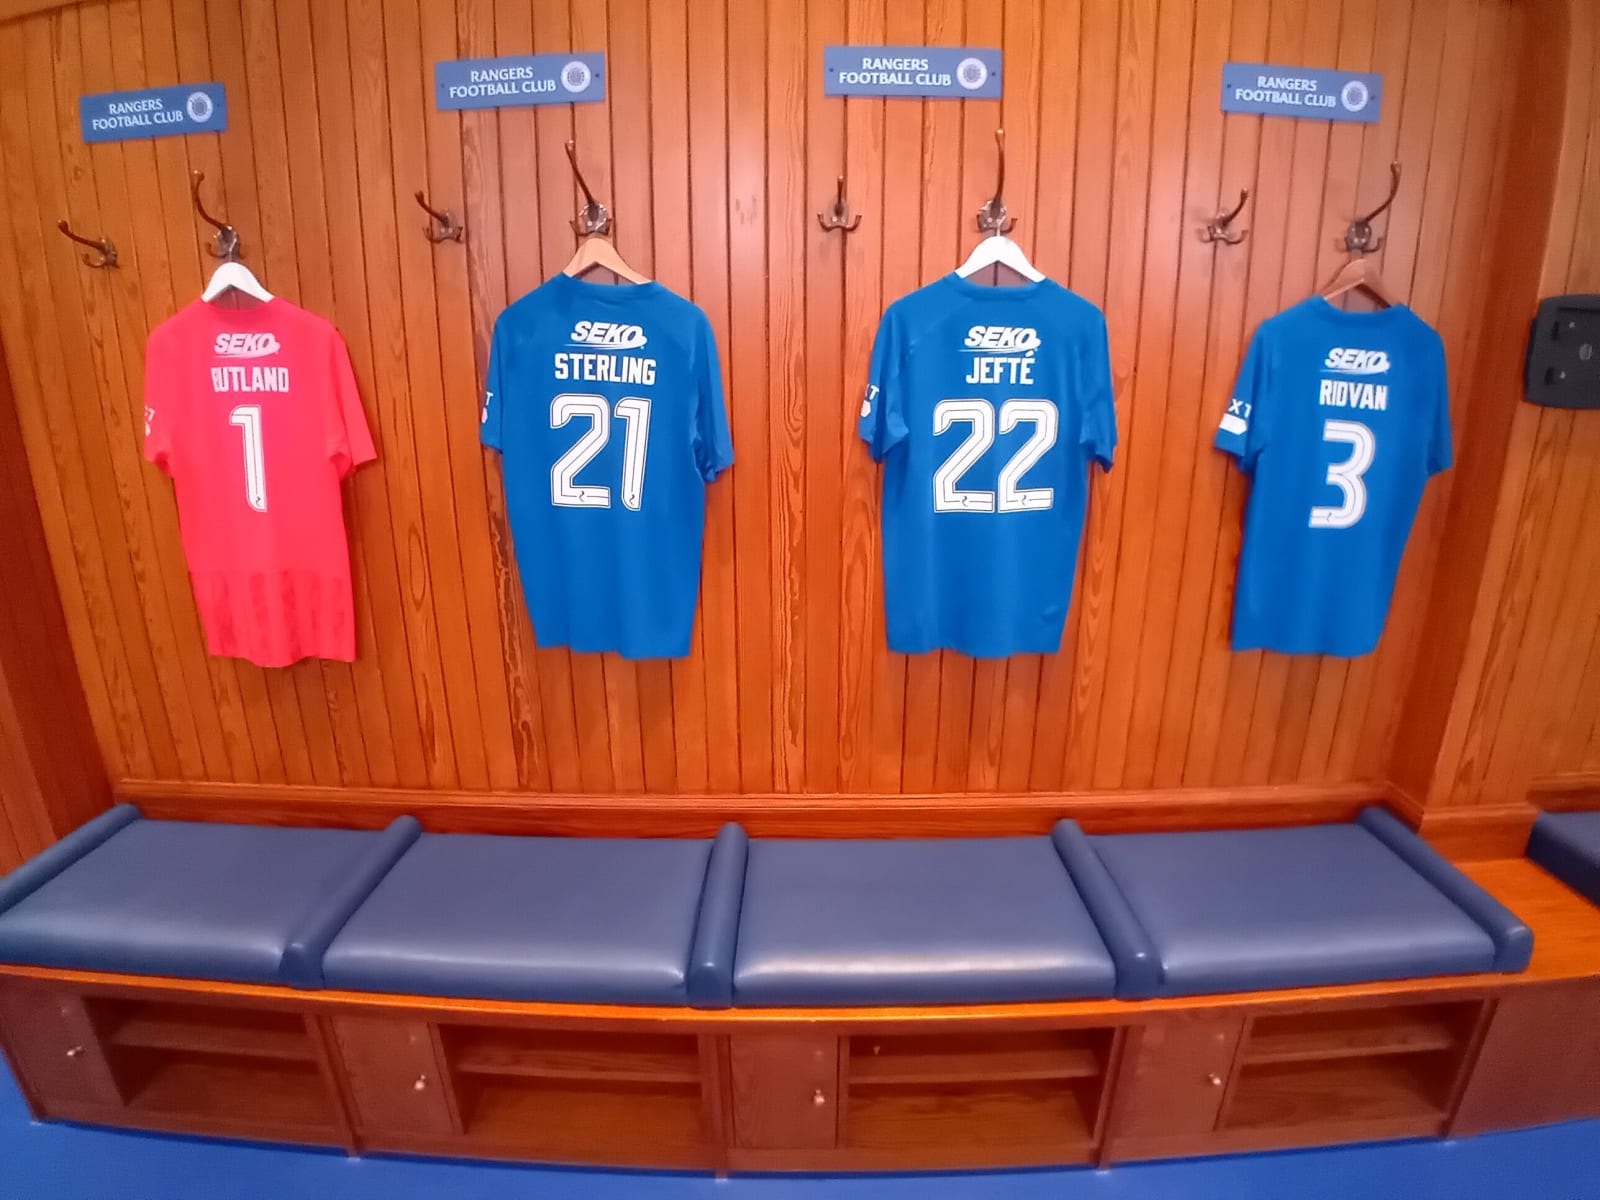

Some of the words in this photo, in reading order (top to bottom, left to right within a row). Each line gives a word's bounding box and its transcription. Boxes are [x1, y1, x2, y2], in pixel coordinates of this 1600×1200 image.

[470, 66, 534, 83] RANGERS
[862, 57, 929, 71] RANGERS
[449, 83, 519, 99] FOOTBALL
[521, 79, 556, 94] CLUB
[839, 72, 913, 86] FOOTBALL
[915, 73, 951, 87] CLUB
[1257, 75, 1318, 92] RANGERS
[108, 98, 163, 115] RANGERS
[1235, 88, 1302, 106] FOOTBALL
[1304, 93, 1336, 108] CLUB
[92, 113, 152, 131] FOOTBALL
[153, 110, 183, 124] CLUB
[214, 332, 280, 355] SEKO
[571, 320, 647, 346] SEKO
[964, 325, 1041, 350] SEKO
[554, 353, 657, 386] STERLING
[965, 350, 1036, 385] JEFTÉ
[1324, 347, 1391, 372] SEKO
[1319, 378, 1388, 410] RIDVAN
[229, 404, 268, 512] 1
[550, 393, 652, 511] 21
[933, 398, 1060, 513] 22
[1308, 418, 1376, 528] 3
